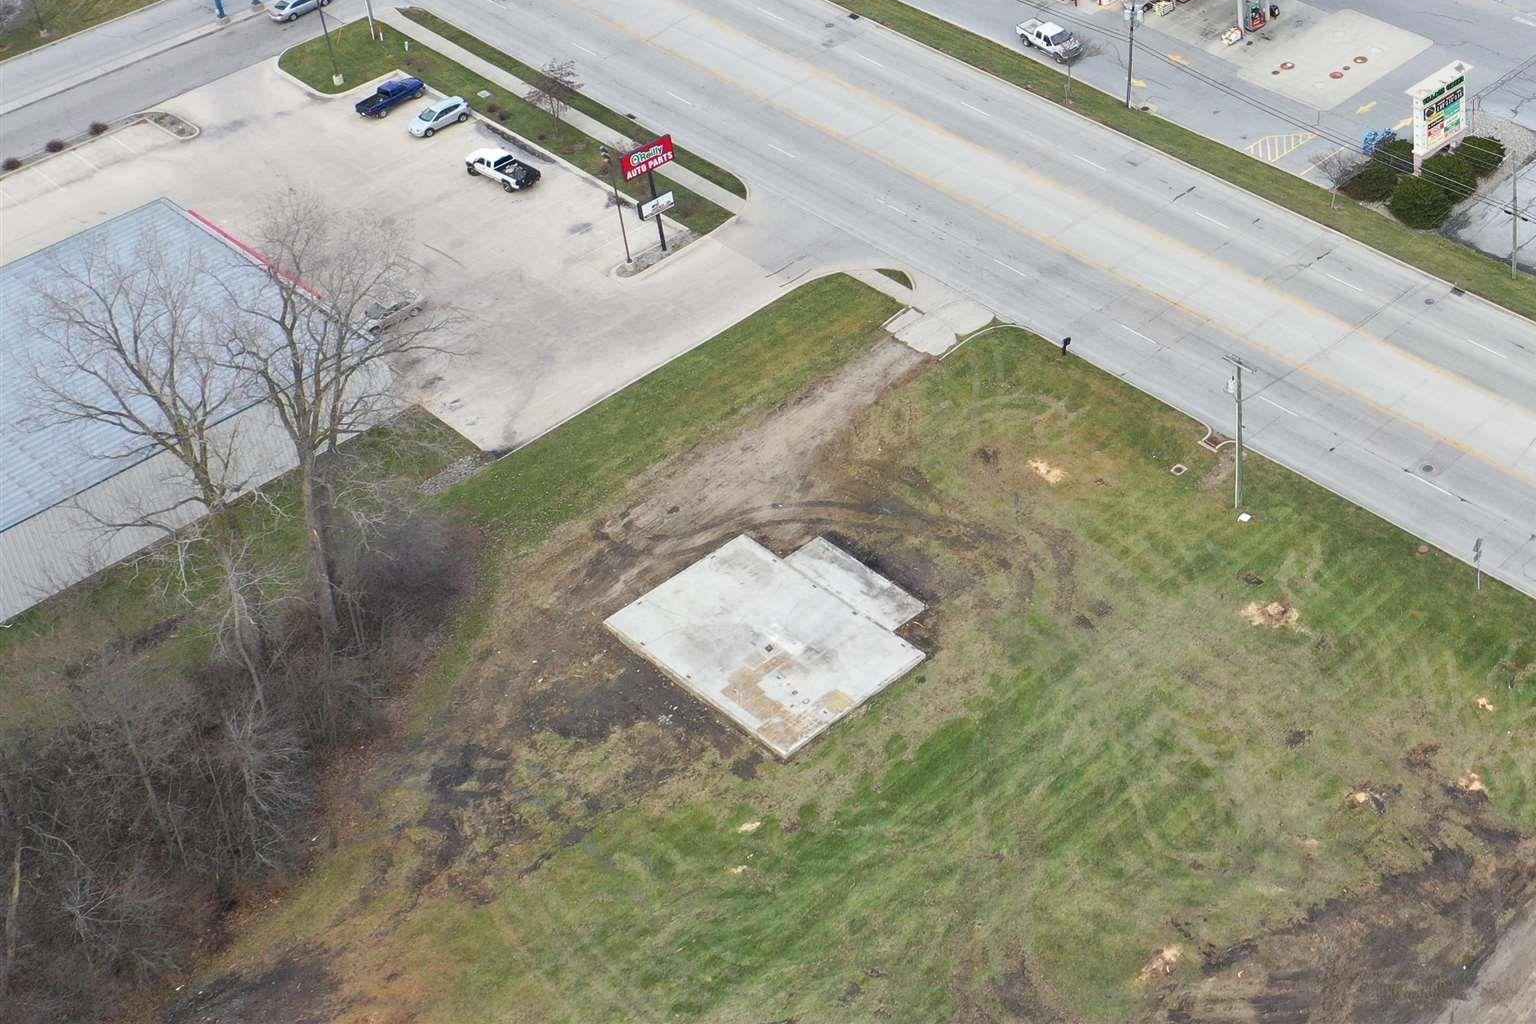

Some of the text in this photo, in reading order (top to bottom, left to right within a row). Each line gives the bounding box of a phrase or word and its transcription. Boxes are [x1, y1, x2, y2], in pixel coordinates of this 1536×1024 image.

[626, 151, 673, 180] AUTO PARTS
[630, 144, 664, 167] O'Reilly
